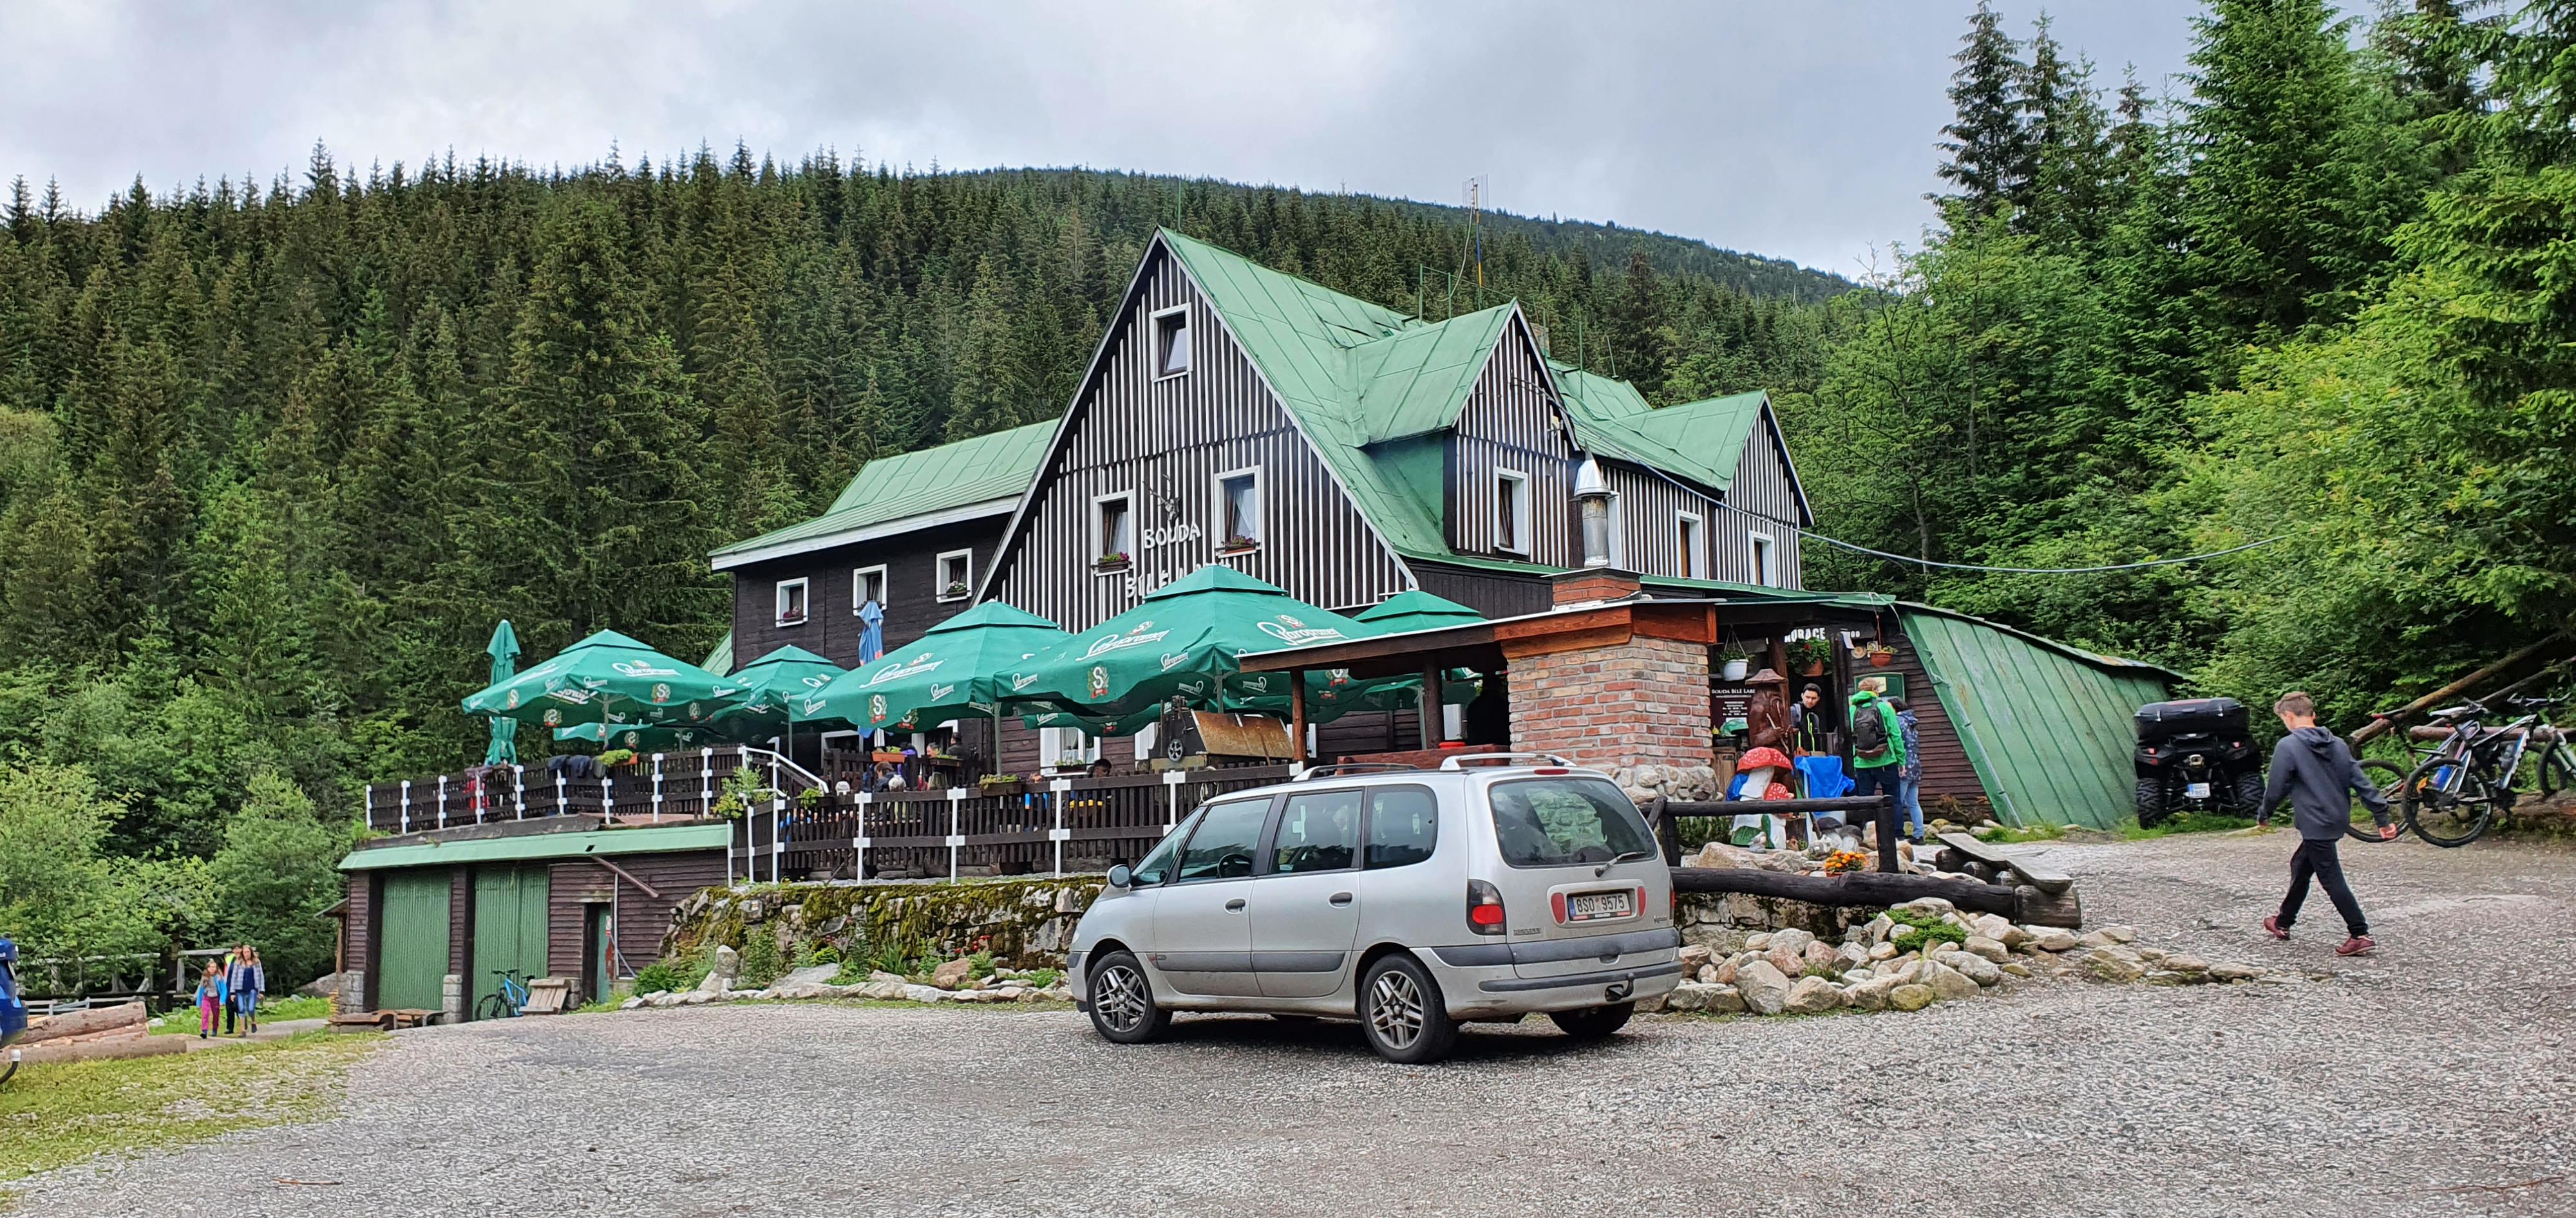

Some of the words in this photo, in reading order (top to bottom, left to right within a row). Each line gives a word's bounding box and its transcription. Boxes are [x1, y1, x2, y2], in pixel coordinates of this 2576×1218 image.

[1144, 523, 1202, 549] BOUDA
[1092, 666, 1104, 689] S
[657, 684, 667, 697] S
[873, 695, 883, 715] S
[1601, 895, 1624, 911] 9575
